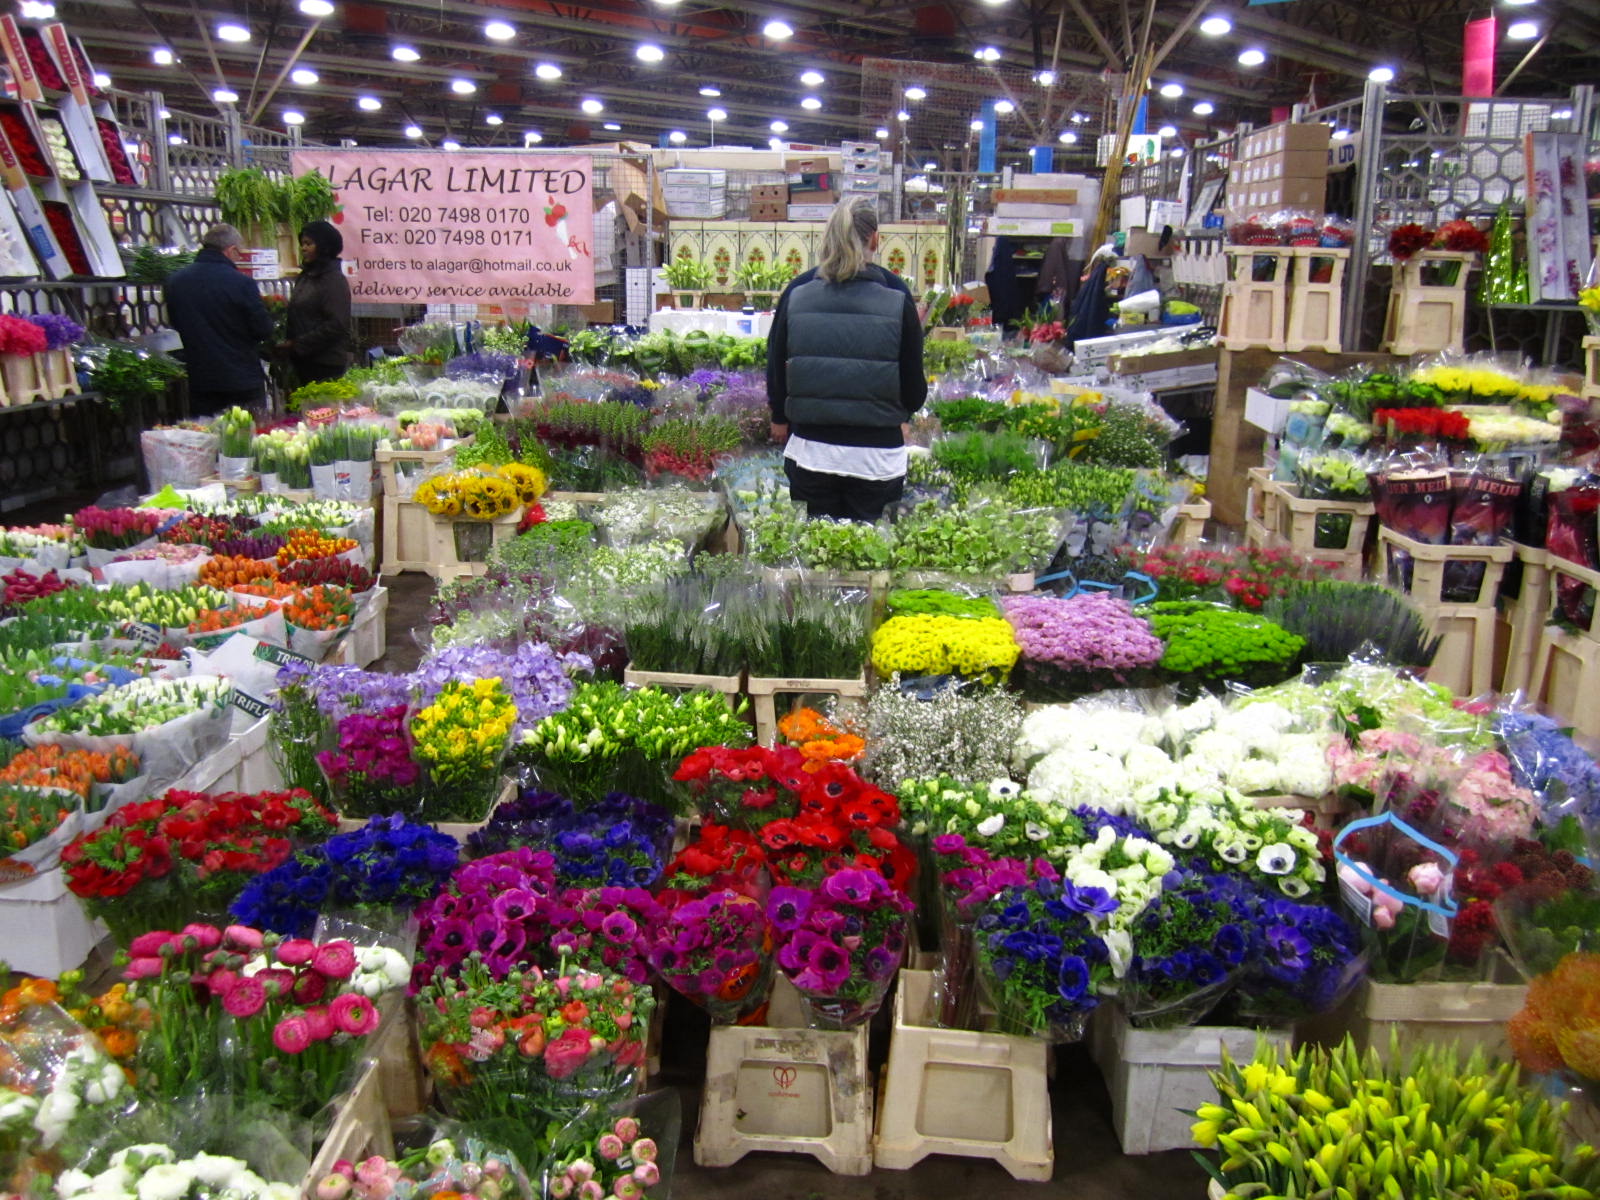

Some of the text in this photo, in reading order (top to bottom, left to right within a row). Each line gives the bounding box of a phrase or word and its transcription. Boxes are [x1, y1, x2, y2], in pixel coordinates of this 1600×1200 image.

[313, 164, 586, 194] LAGAR LIMITED
[363, 206, 530, 224] Tel: 020 7498 0170
[361, 228, 532, 246] Fax: 020 7498 0171
[364, 257, 407, 270] orders
[411, 258, 423, 270] to
[427, 258, 572, 273] alagar@hotmail.co.uk
[353, 281, 575, 299] delivery service available
